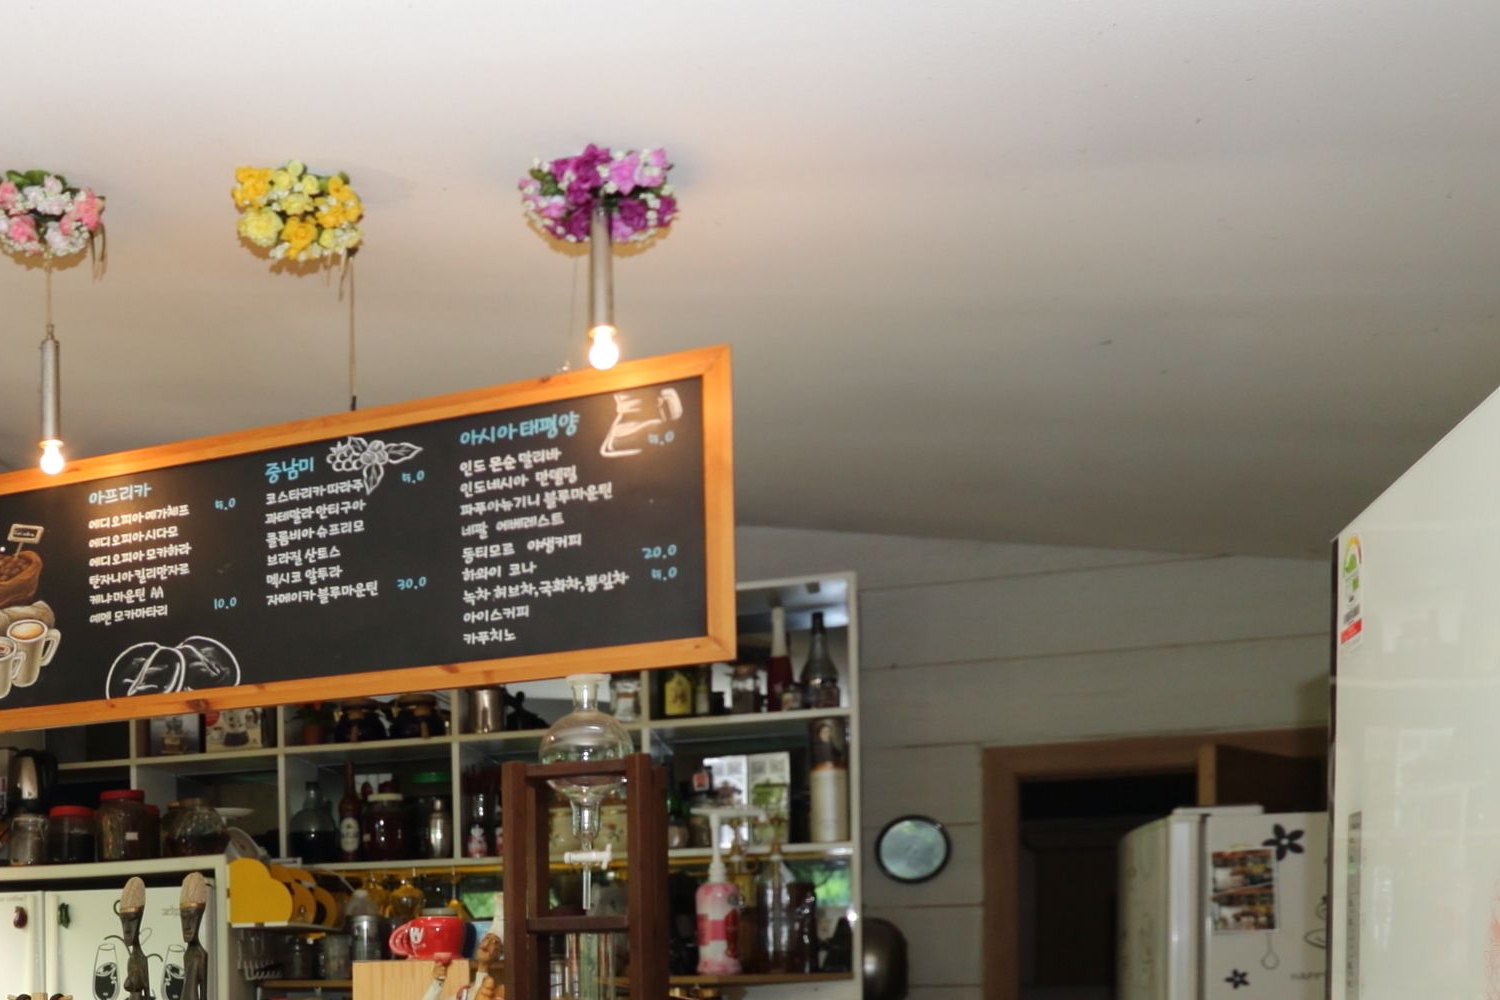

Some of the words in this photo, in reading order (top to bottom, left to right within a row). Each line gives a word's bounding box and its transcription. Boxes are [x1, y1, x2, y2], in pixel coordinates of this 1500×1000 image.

[264, 456, 314, 483] 중남미
[88, 483, 152, 505] 아프리카
[265, 484, 329, 505] 코스타리카
[326, 478, 366, 494] 따라주
[459, 474, 529, 498] 인도네시아
[315, 498, 367, 519] 안티구아
[459, 493, 540, 515] 파푸아뉴기니
[543, 481, 613, 509] 블루마운틴
[88, 511, 145, 529] 에디오피아
[495, 511, 565, 531] 에베레스트
[88, 531, 145, 548] 에디오피아
[144, 525, 179, 540] 시다모
[265, 527, 315, 549] 콜롬비아
[316, 519, 365, 538] 슈프리모
[88, 550, 145, 567] 에디오피아
[146, 541, 193, 560] 모카하라
[266, 549, 303, 566] 브라질
[304, 545, 342, 563] 산토스
[461, 542, 516, 564] 동티모르
[526, 532, 583, 554] 야생커피
[641, 544, 678, 560] 20.0
[88, 570, 135, 589] 탄자니아
[134, 562, 191, 584] 킬리만자로
[265, 571, 302, 588] 멕시코
[305, 564, 344, 584] 알투라
[461, 565, 502, 581] 하와이
[508, 560, 538, 576] 코나
[265, 589, 317, 605] 자메이카
[316, 579, 379, 604] 블루마운틴
[396, 576, 428, 591] 30.0
[113, 603, 169, 622] 모카마타리
[213, 596, 238, 610] 10.0
[462, 604, 530, 623] 아이스커피
[462, 627, 517, 645] 카푸치노
